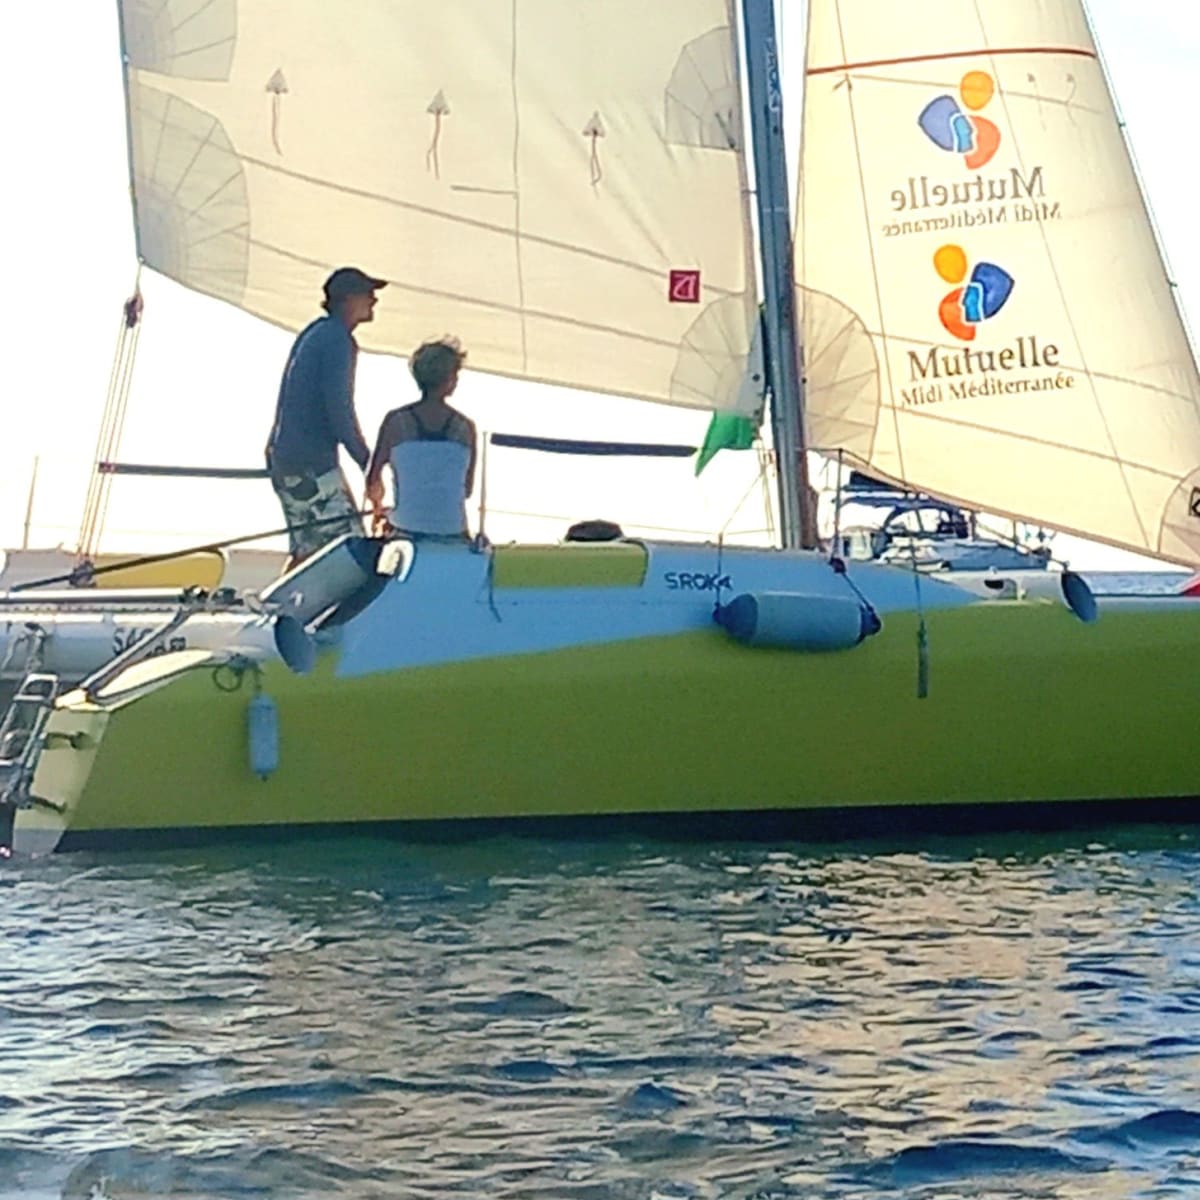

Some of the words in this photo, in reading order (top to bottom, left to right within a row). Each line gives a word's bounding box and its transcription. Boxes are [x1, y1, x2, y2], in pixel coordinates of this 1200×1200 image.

[907, 335, 1060, 383] Mutuelle
[900, 386, 943, 409] Midi
[664, 572, 733, 590] SROKA
